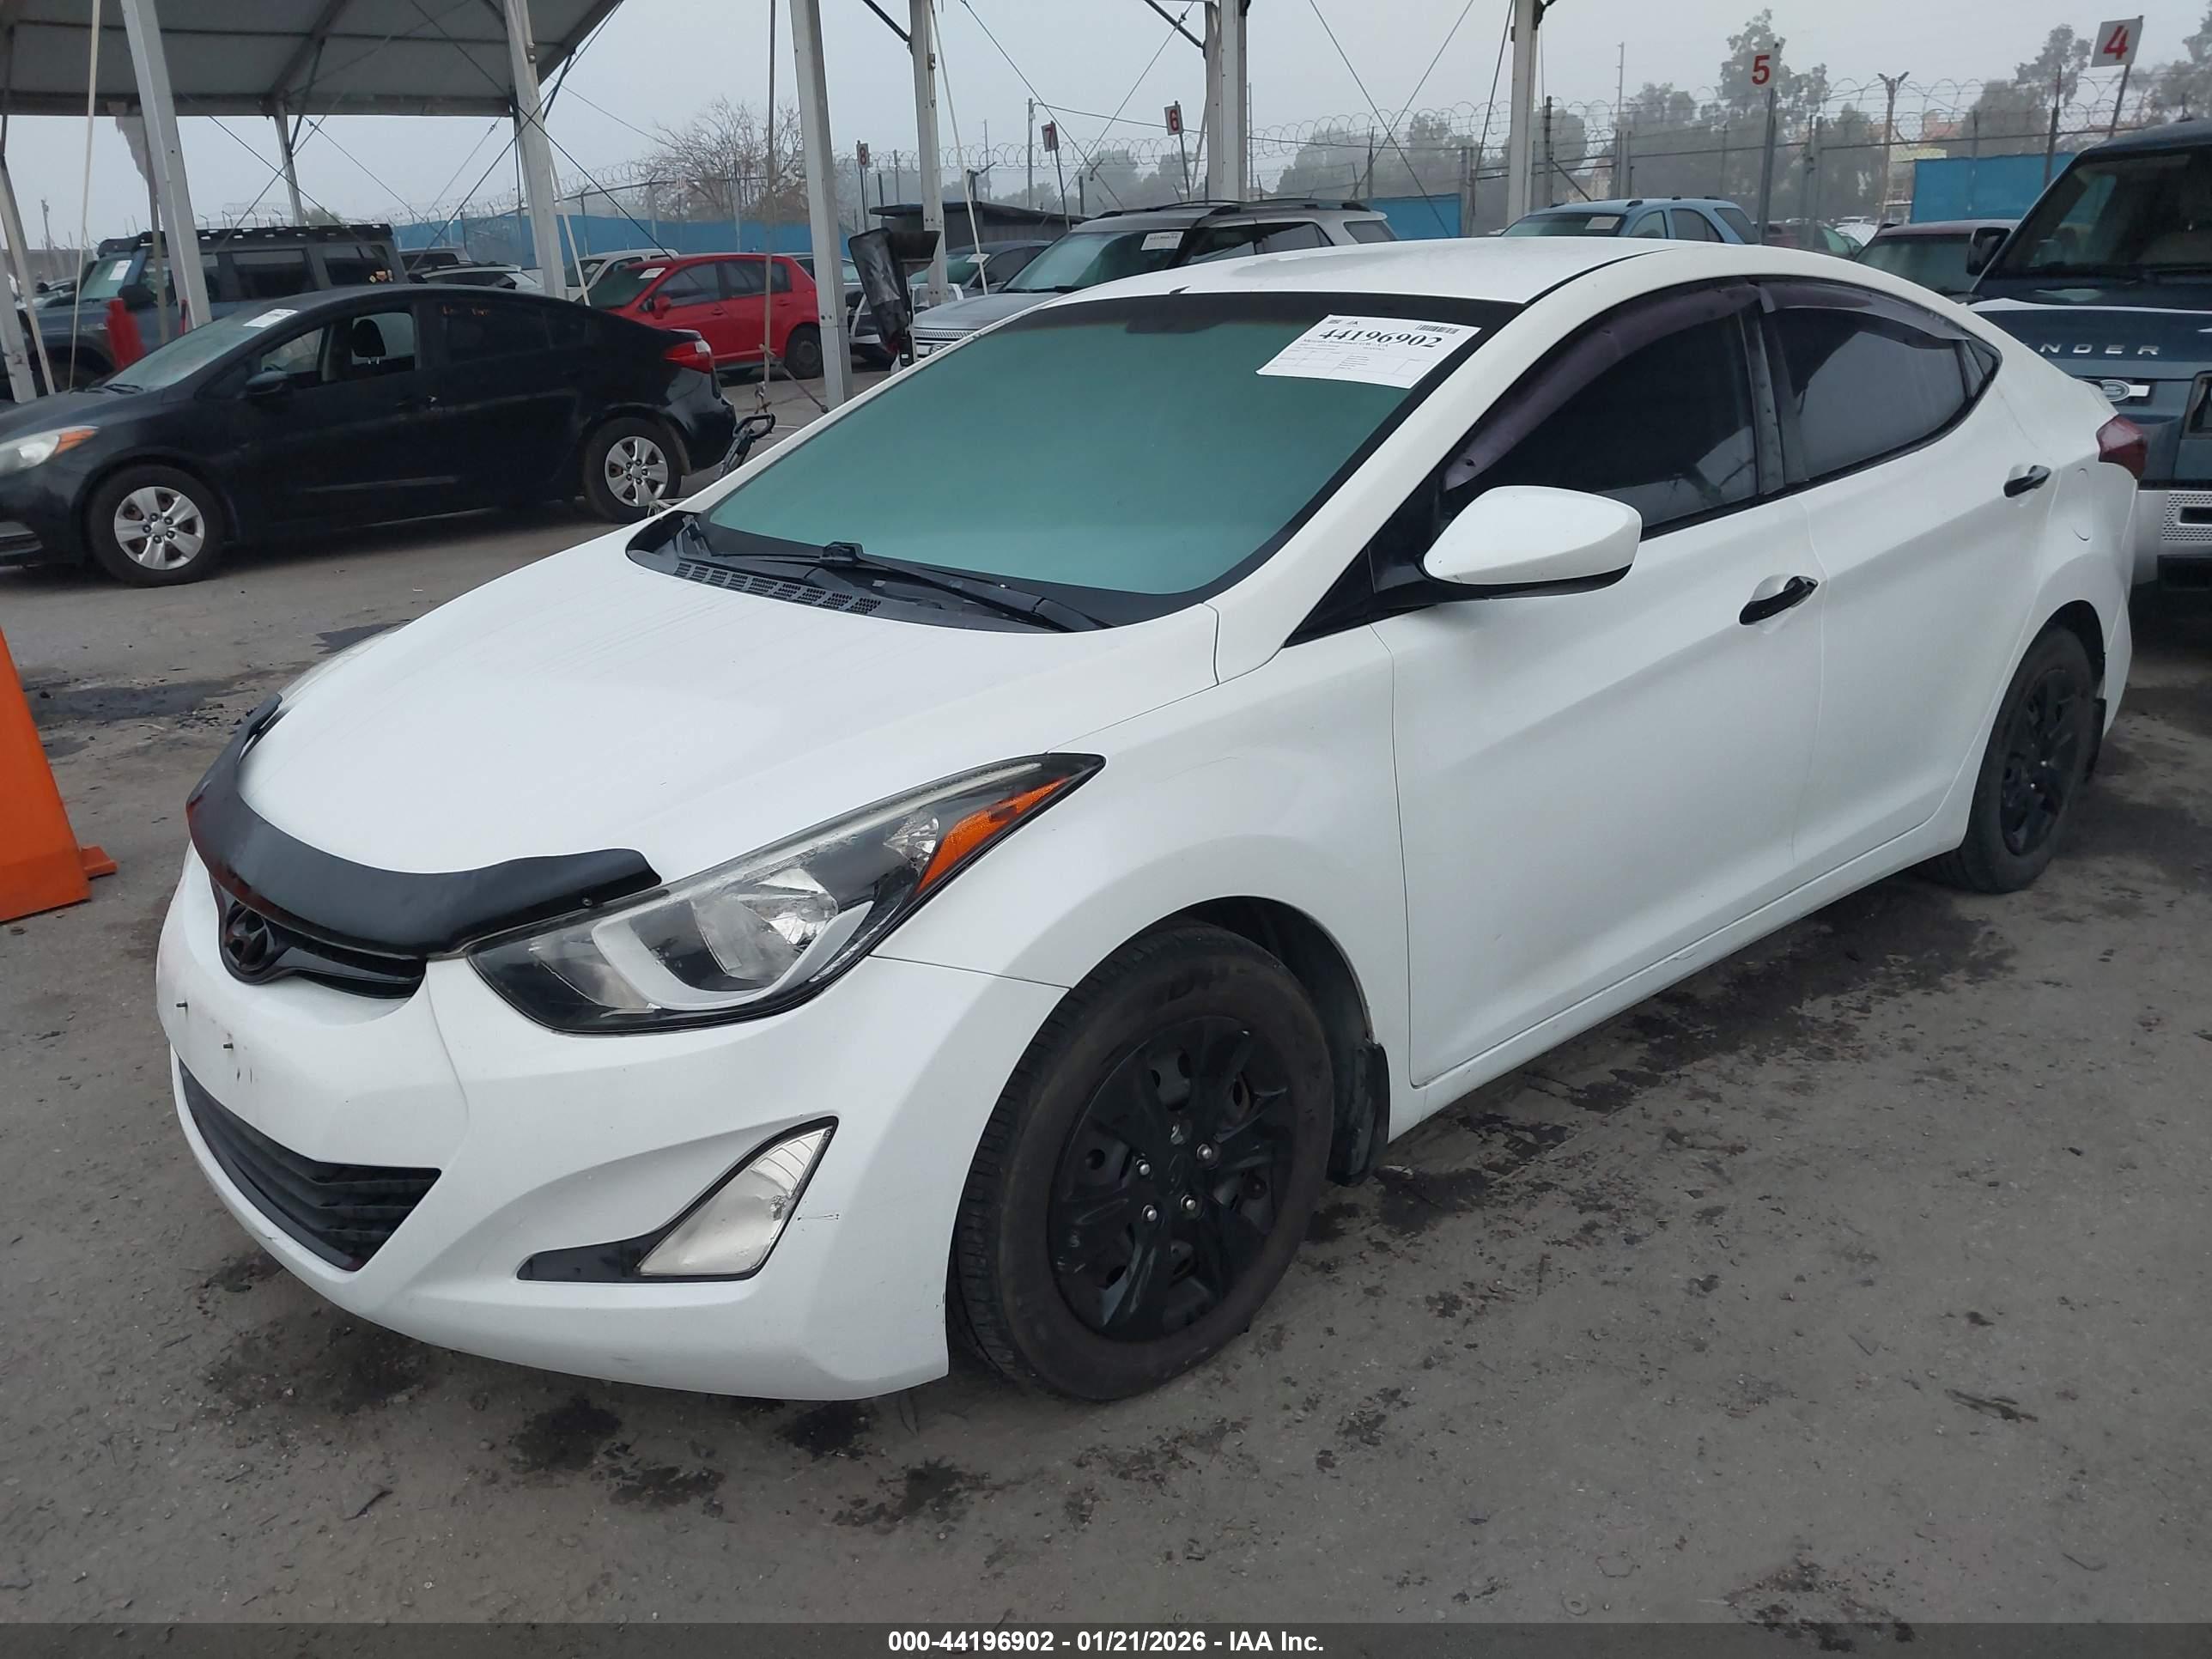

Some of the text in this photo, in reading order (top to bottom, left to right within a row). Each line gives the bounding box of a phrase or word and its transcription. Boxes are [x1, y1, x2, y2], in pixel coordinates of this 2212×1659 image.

[2102, 24, 2129, 60] 4
[1751, 54, 1771, 85] 5
[1169, 109, 1179, 131] 6
[1044, 127, 1054, 148] 7
[859, 146, 866, 166] 8
[1318, 328, 1443, 349] 44196902
[2039, 343, 2160, 356] NDER
